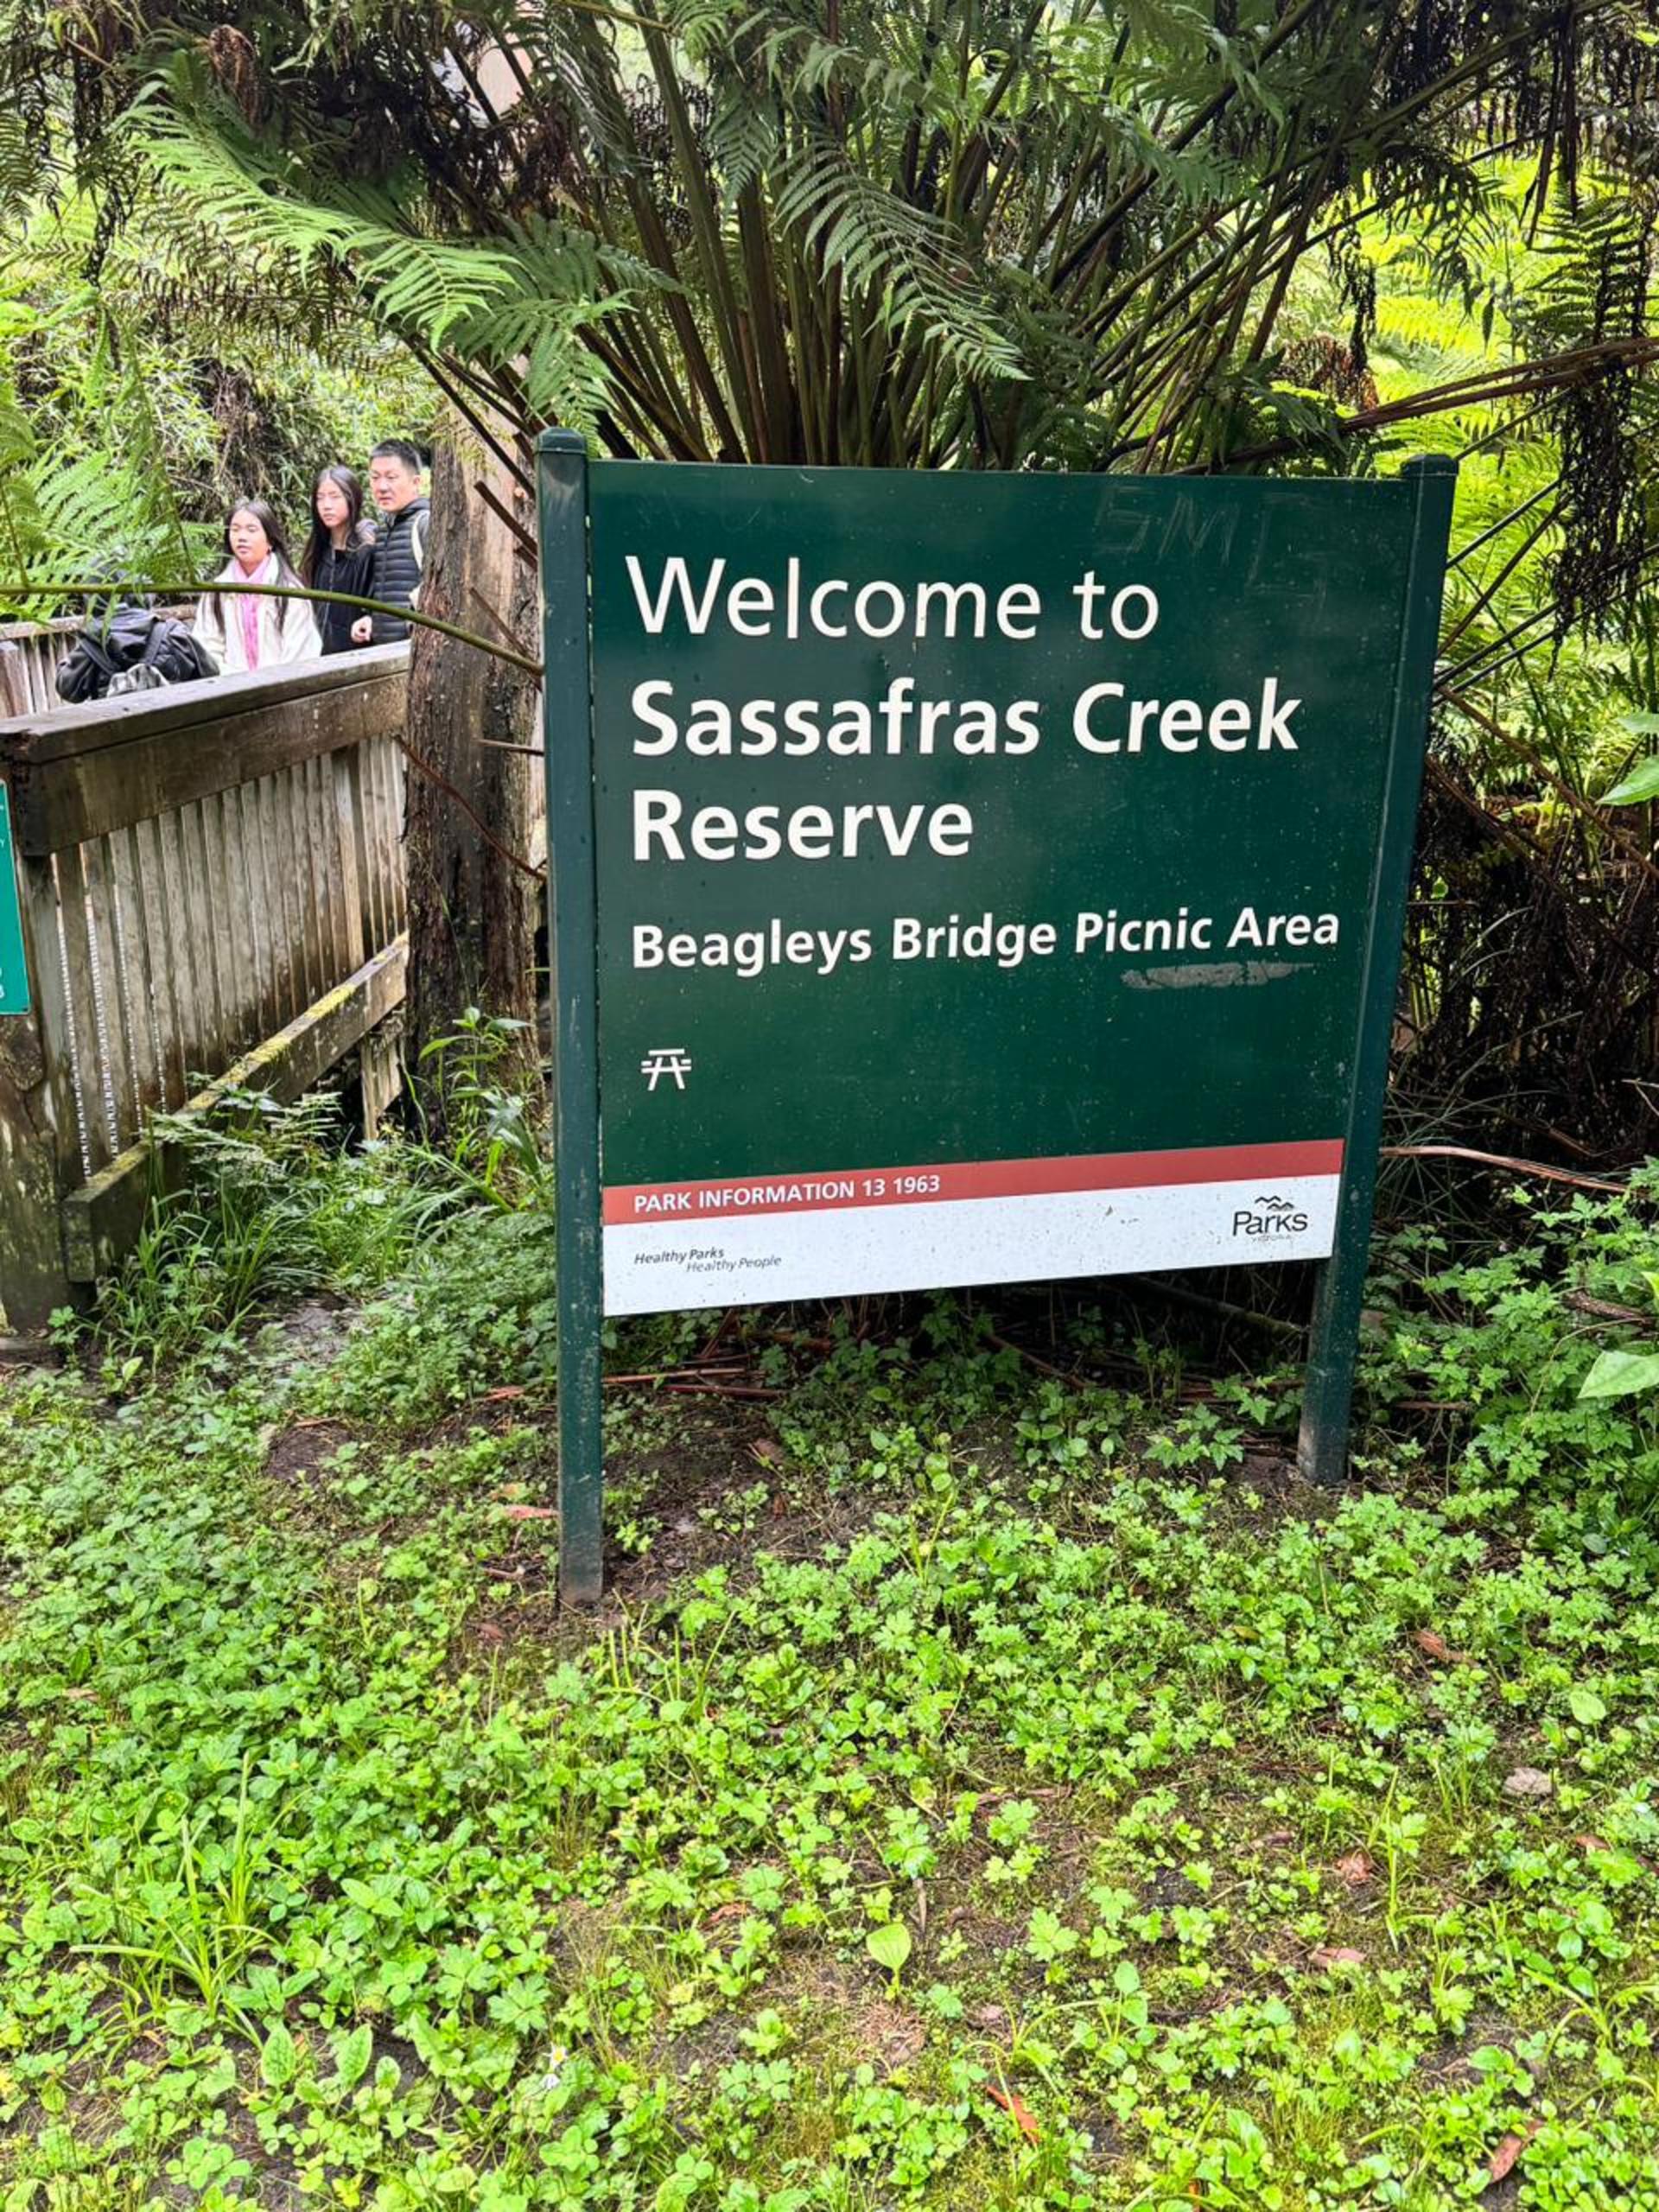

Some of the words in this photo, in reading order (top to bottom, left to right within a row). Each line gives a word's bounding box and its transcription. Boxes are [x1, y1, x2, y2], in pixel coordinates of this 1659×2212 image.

[626, 556, 1040, 639] Welcome
[1073, 571, 1158, 639] to
[632, 677, 1039, 755] Sassafras
[1073, 677, 1300, 753] Creek
[634, 790, 972, 860] Reserve
[634, 919, 871, 976] Beagleys
[893, 913, 1056, 967] Bridge
[1077, 908, 1211, 952] Picnic
[1227, 908, 1338, 947] Area
[635, 1192, 691, 1213] PARK
[699, 1181, 855, 1208] INFORMATION
[863, 1179, 885, 1196] 13
[893, 1175, 939, 1193] 1963
[1232, 1211, 1308, 1236] Parks
[635, 1252, 686, 1263] Healthy
[690, 1248, 723, 1259] Parks
[687, 1261, 736, 1272] Healthy
[739, 1256, 781, 1268] People
